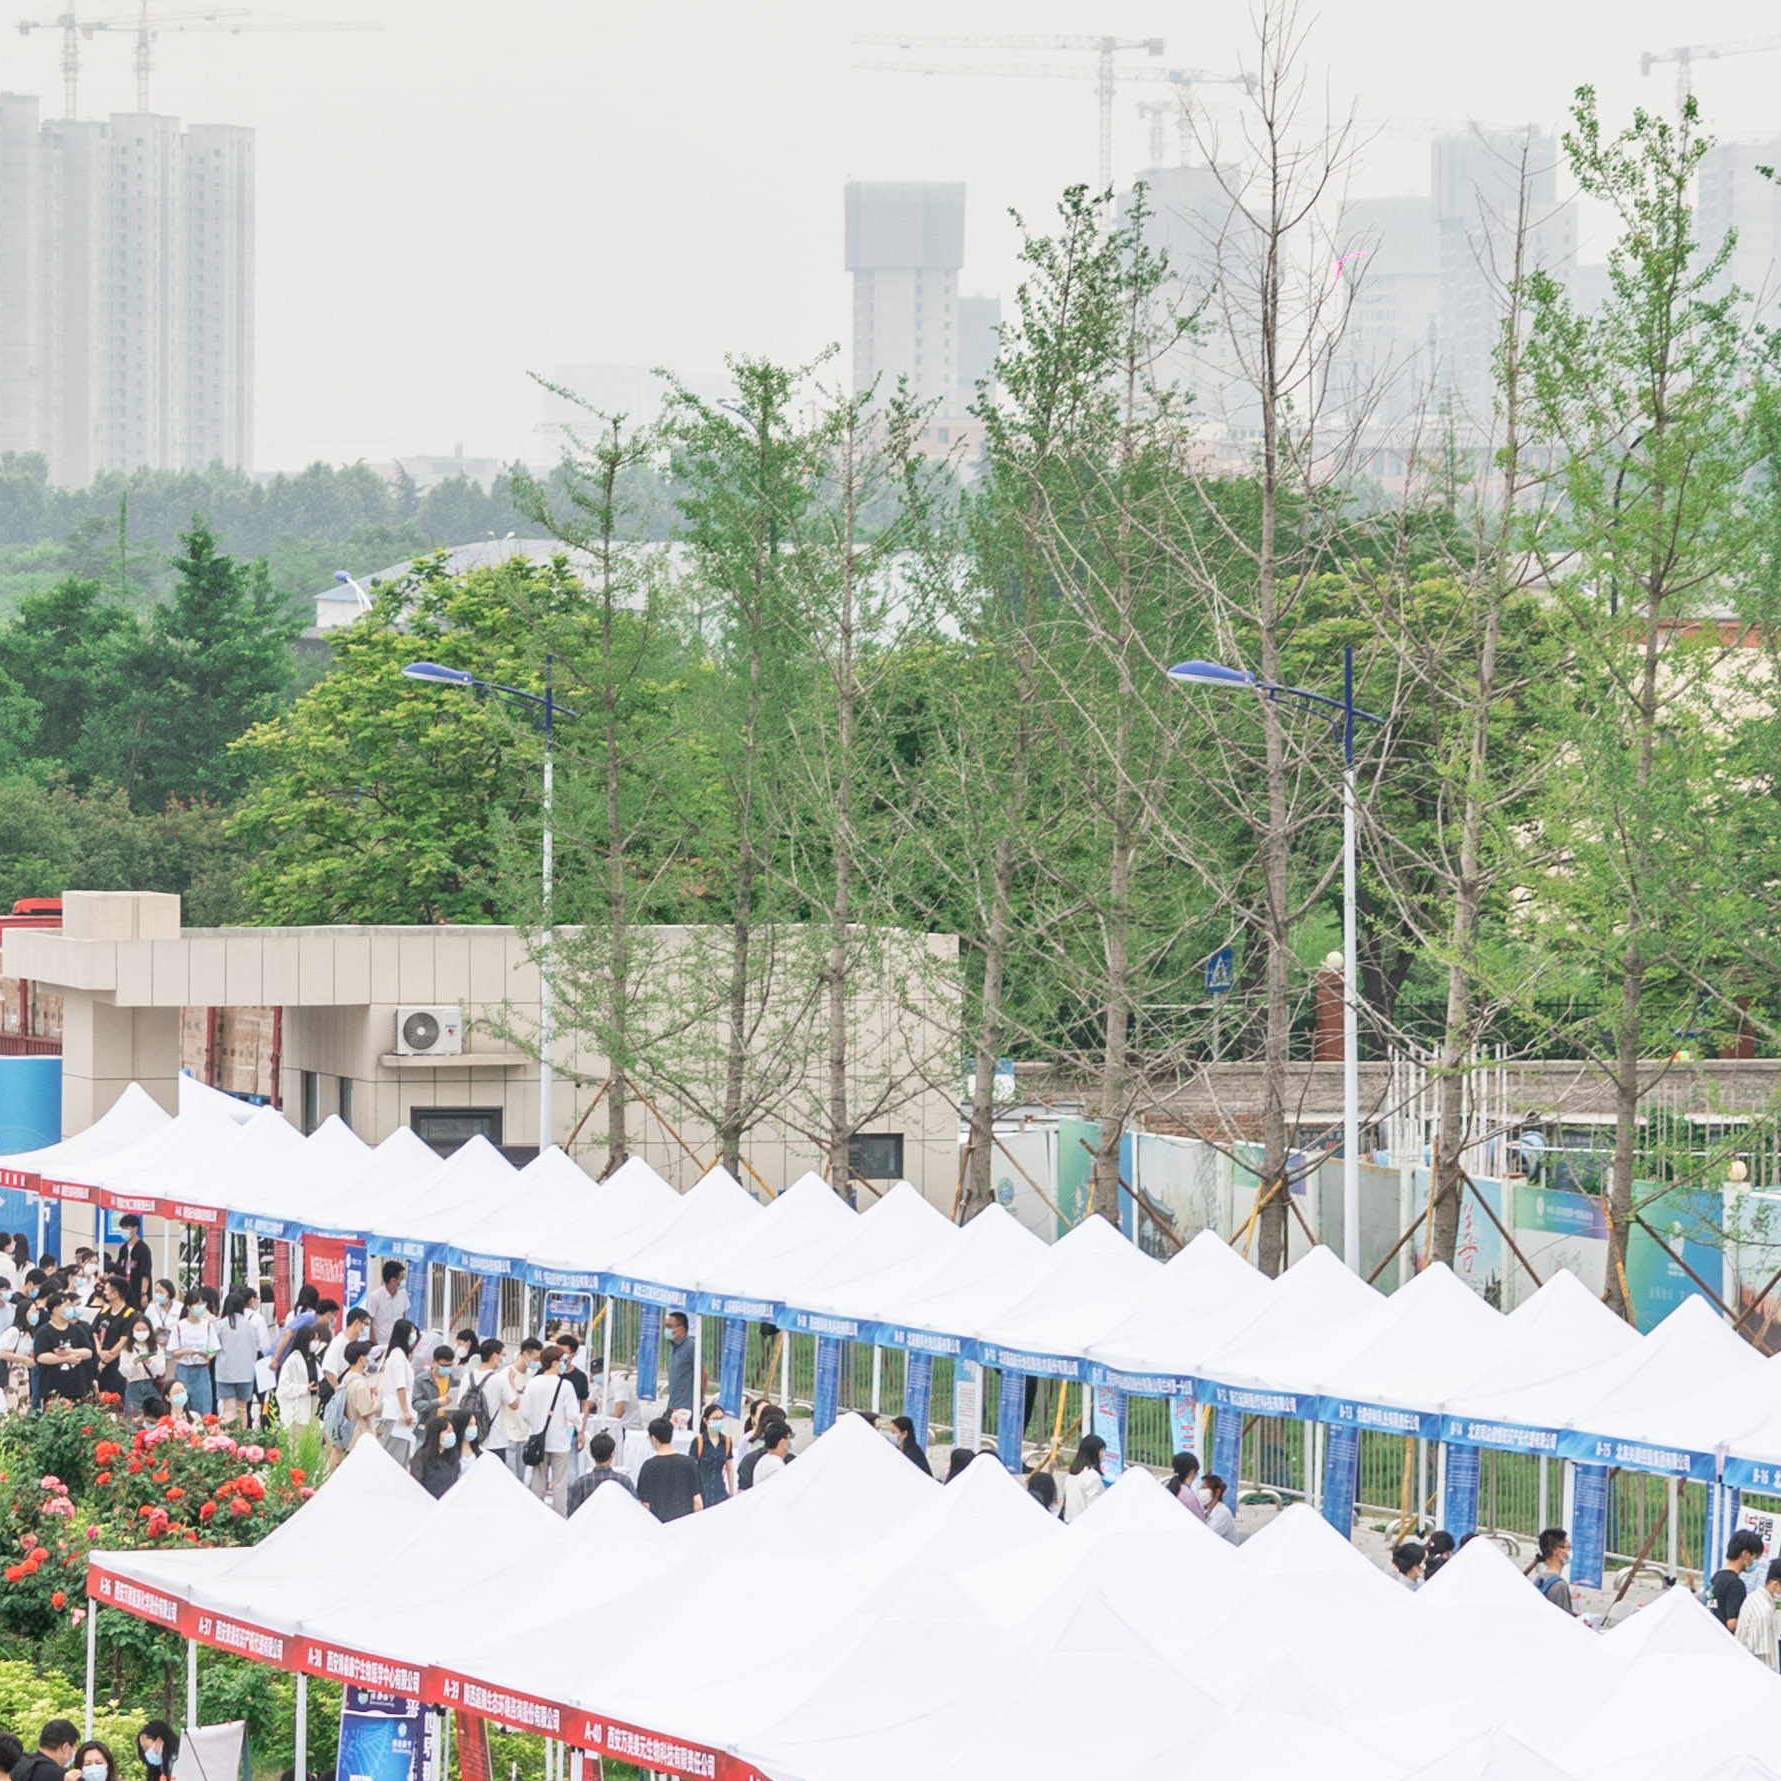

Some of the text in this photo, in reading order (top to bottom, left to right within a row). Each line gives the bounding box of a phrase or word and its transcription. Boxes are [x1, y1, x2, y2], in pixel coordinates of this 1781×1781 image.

[307, 1647, 323, 1668] A-38
[443, 1678, 460, 1699] A-39
[584, 1721, 603, 1744] A-40
